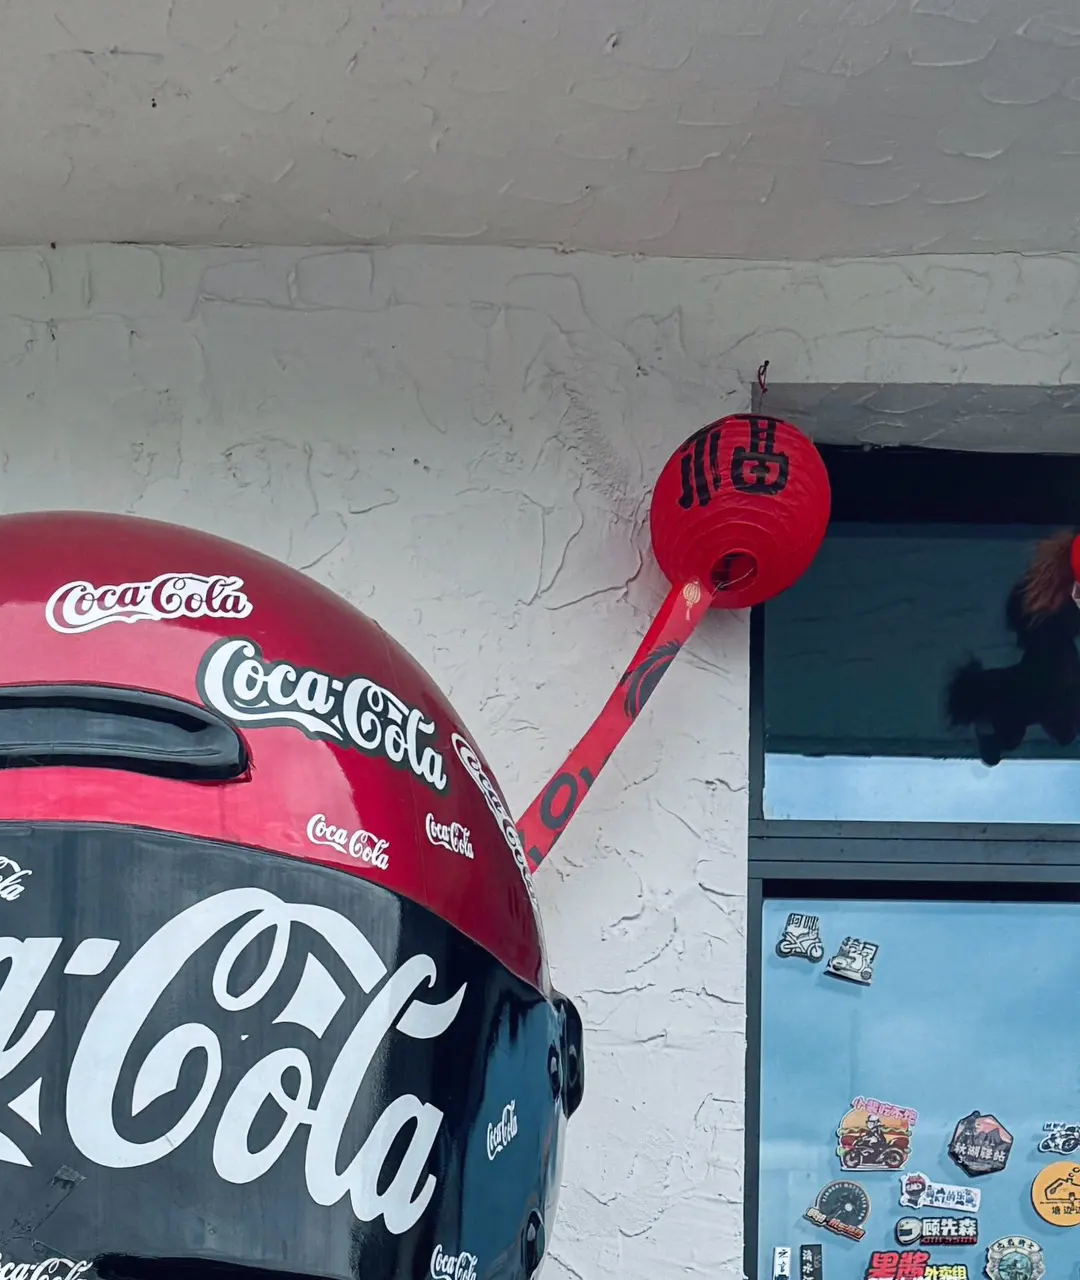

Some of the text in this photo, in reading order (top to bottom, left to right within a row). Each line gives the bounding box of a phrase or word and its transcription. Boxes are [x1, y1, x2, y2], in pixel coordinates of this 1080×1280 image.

[48, 575, 252, 633] Coca-Cola
[204, 640, 447, 790] Coca-Cola
[307, 813, 390, 871] Coca-Cola
[425, 812, 474, 860] Coca-Cola
